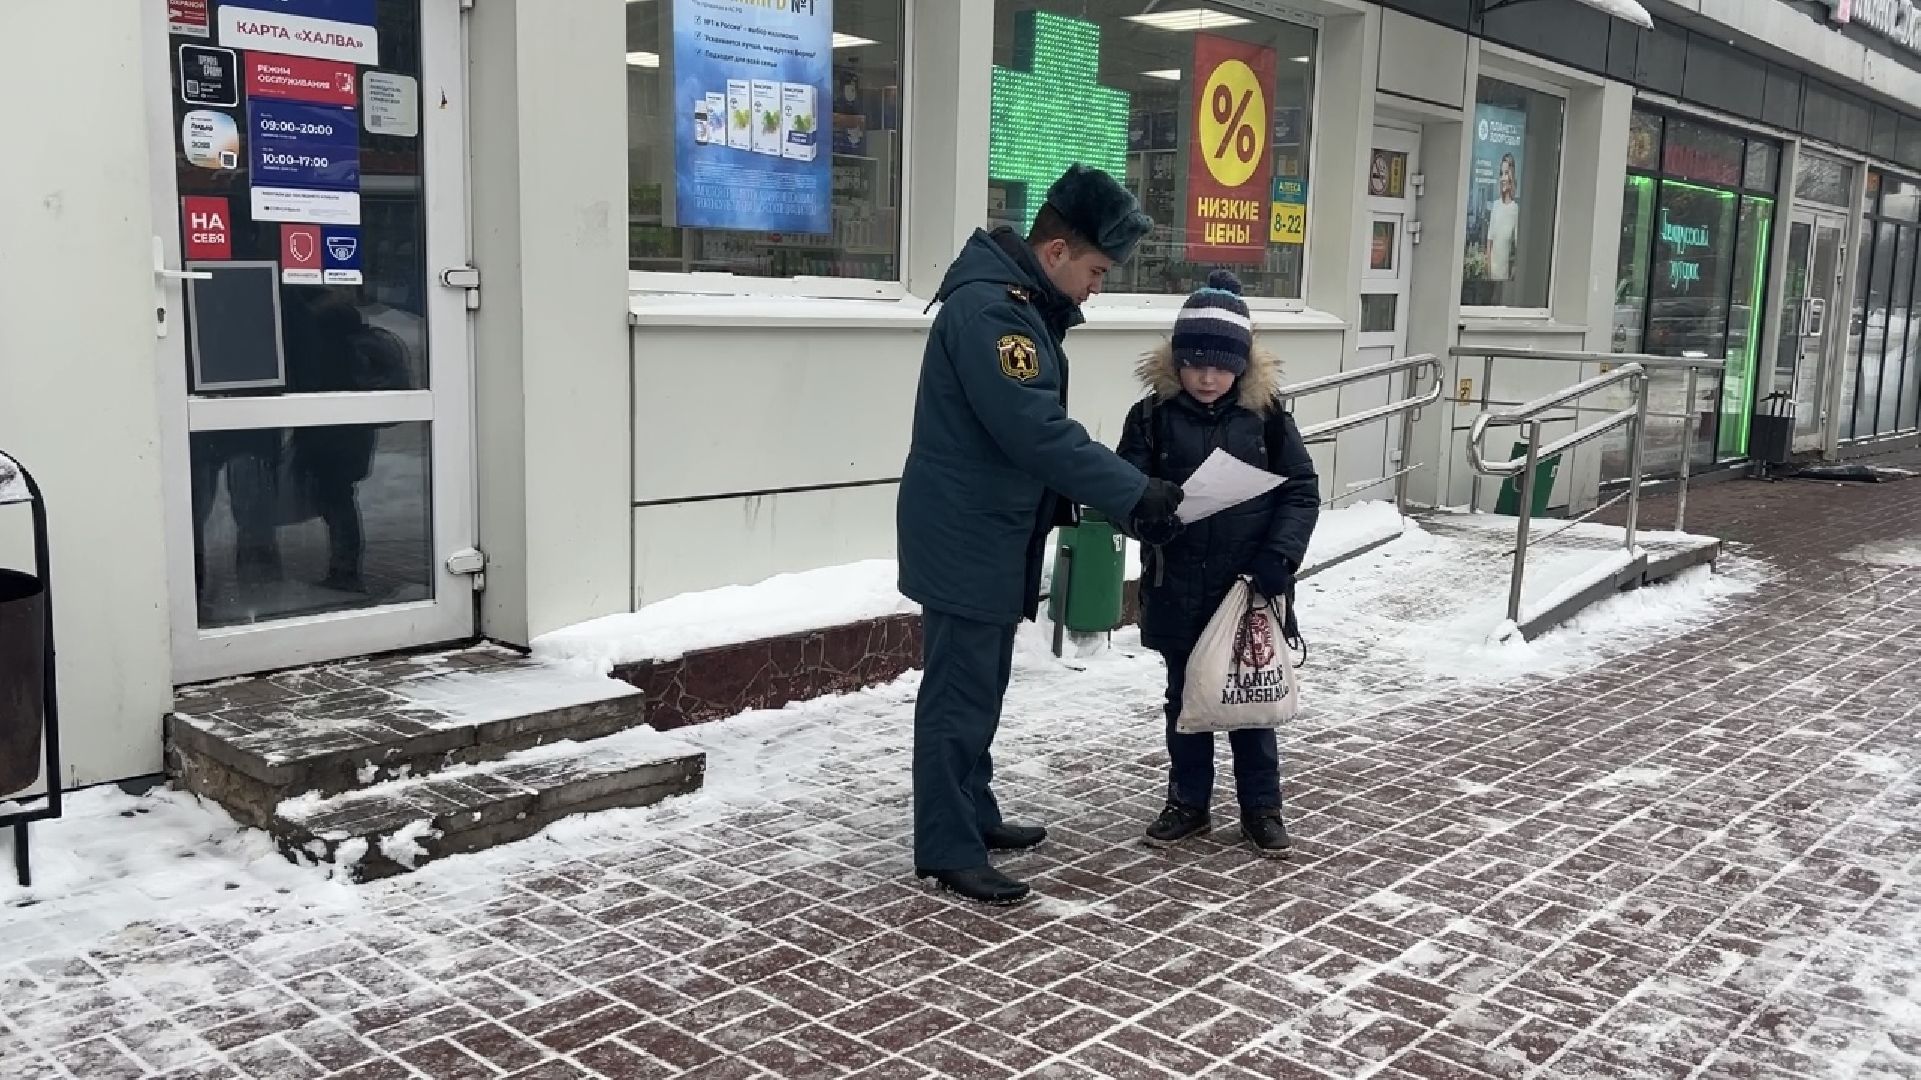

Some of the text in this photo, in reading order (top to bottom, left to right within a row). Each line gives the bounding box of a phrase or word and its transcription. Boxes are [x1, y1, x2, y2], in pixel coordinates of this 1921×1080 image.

[236, 21, 364, 48] КАРТА «ХАЛВА»
[257, 64, 291, 75] РЕЖИМ
[257, 74, 330, 89] ОБСЛУЖИВАНИЯ
[1197, 196, 1260, 220] НИЗКИЕ
[191, 212, 225, 230] НА
[1274, 212, 1302, 234] 8-22
[191, 232, 225, 244] СЕБЯ
[1204, 221, 1250, 246] ЦЕНЫ
